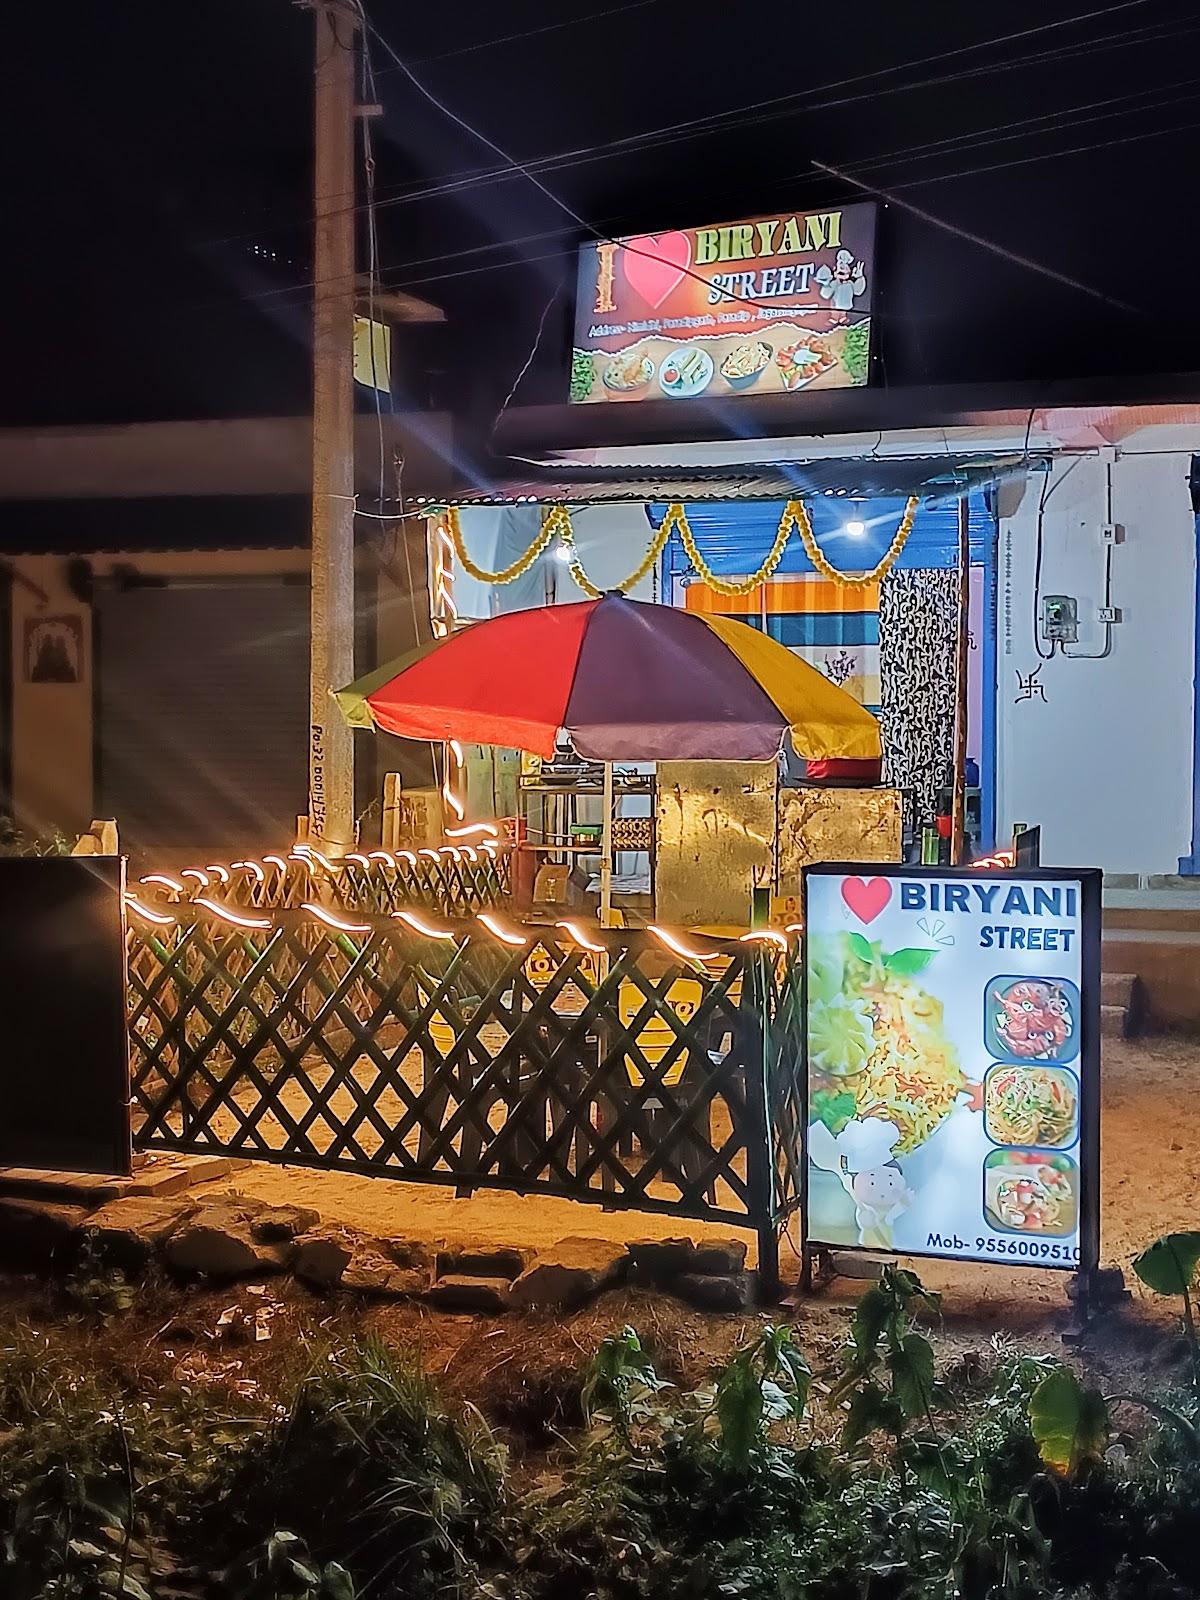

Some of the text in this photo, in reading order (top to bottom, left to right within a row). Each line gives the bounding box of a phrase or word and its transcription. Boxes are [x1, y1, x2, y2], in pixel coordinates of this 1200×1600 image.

[594, 211, 843, 314] I BIRYANI
[708, 262, 815, 305] STREET
[900, 882, 1077, 917] BIRYANI
[980, 925, 1076, 952] STREET
[926, 1233, 1081, 1261] Mob- 9556009510
